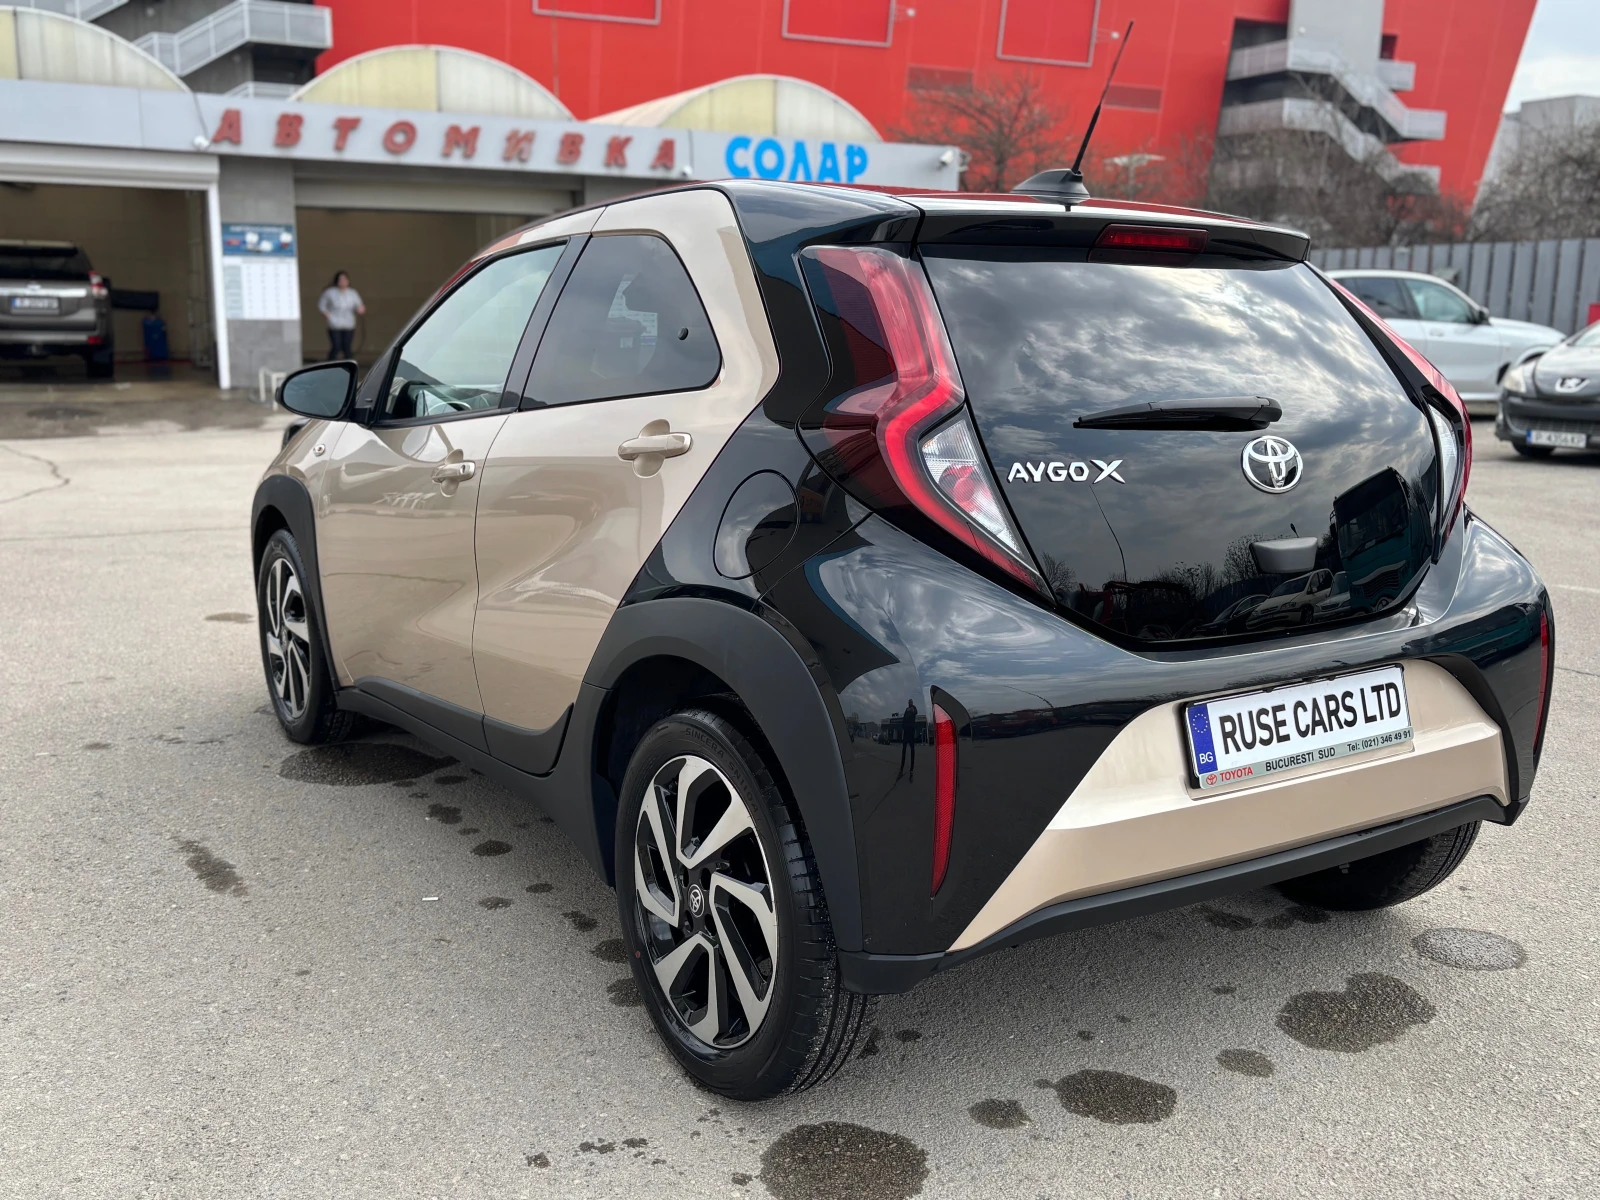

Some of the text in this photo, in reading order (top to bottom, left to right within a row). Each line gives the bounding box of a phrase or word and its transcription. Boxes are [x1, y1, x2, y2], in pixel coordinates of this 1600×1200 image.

[211, 108, 676, 170] АВТОМИВКА
[725, 136, 869, 184] СОЛАР
[685, 727, 725, 758] SINCERA
[1219, 682, 1402, 755] RUSE CARS LTD
[1199, 752, 1214, 765] BG
[1219, 730, 1412, 782] TOYOTA BUCURESTI SUD Tel: (021) 346 49 91
